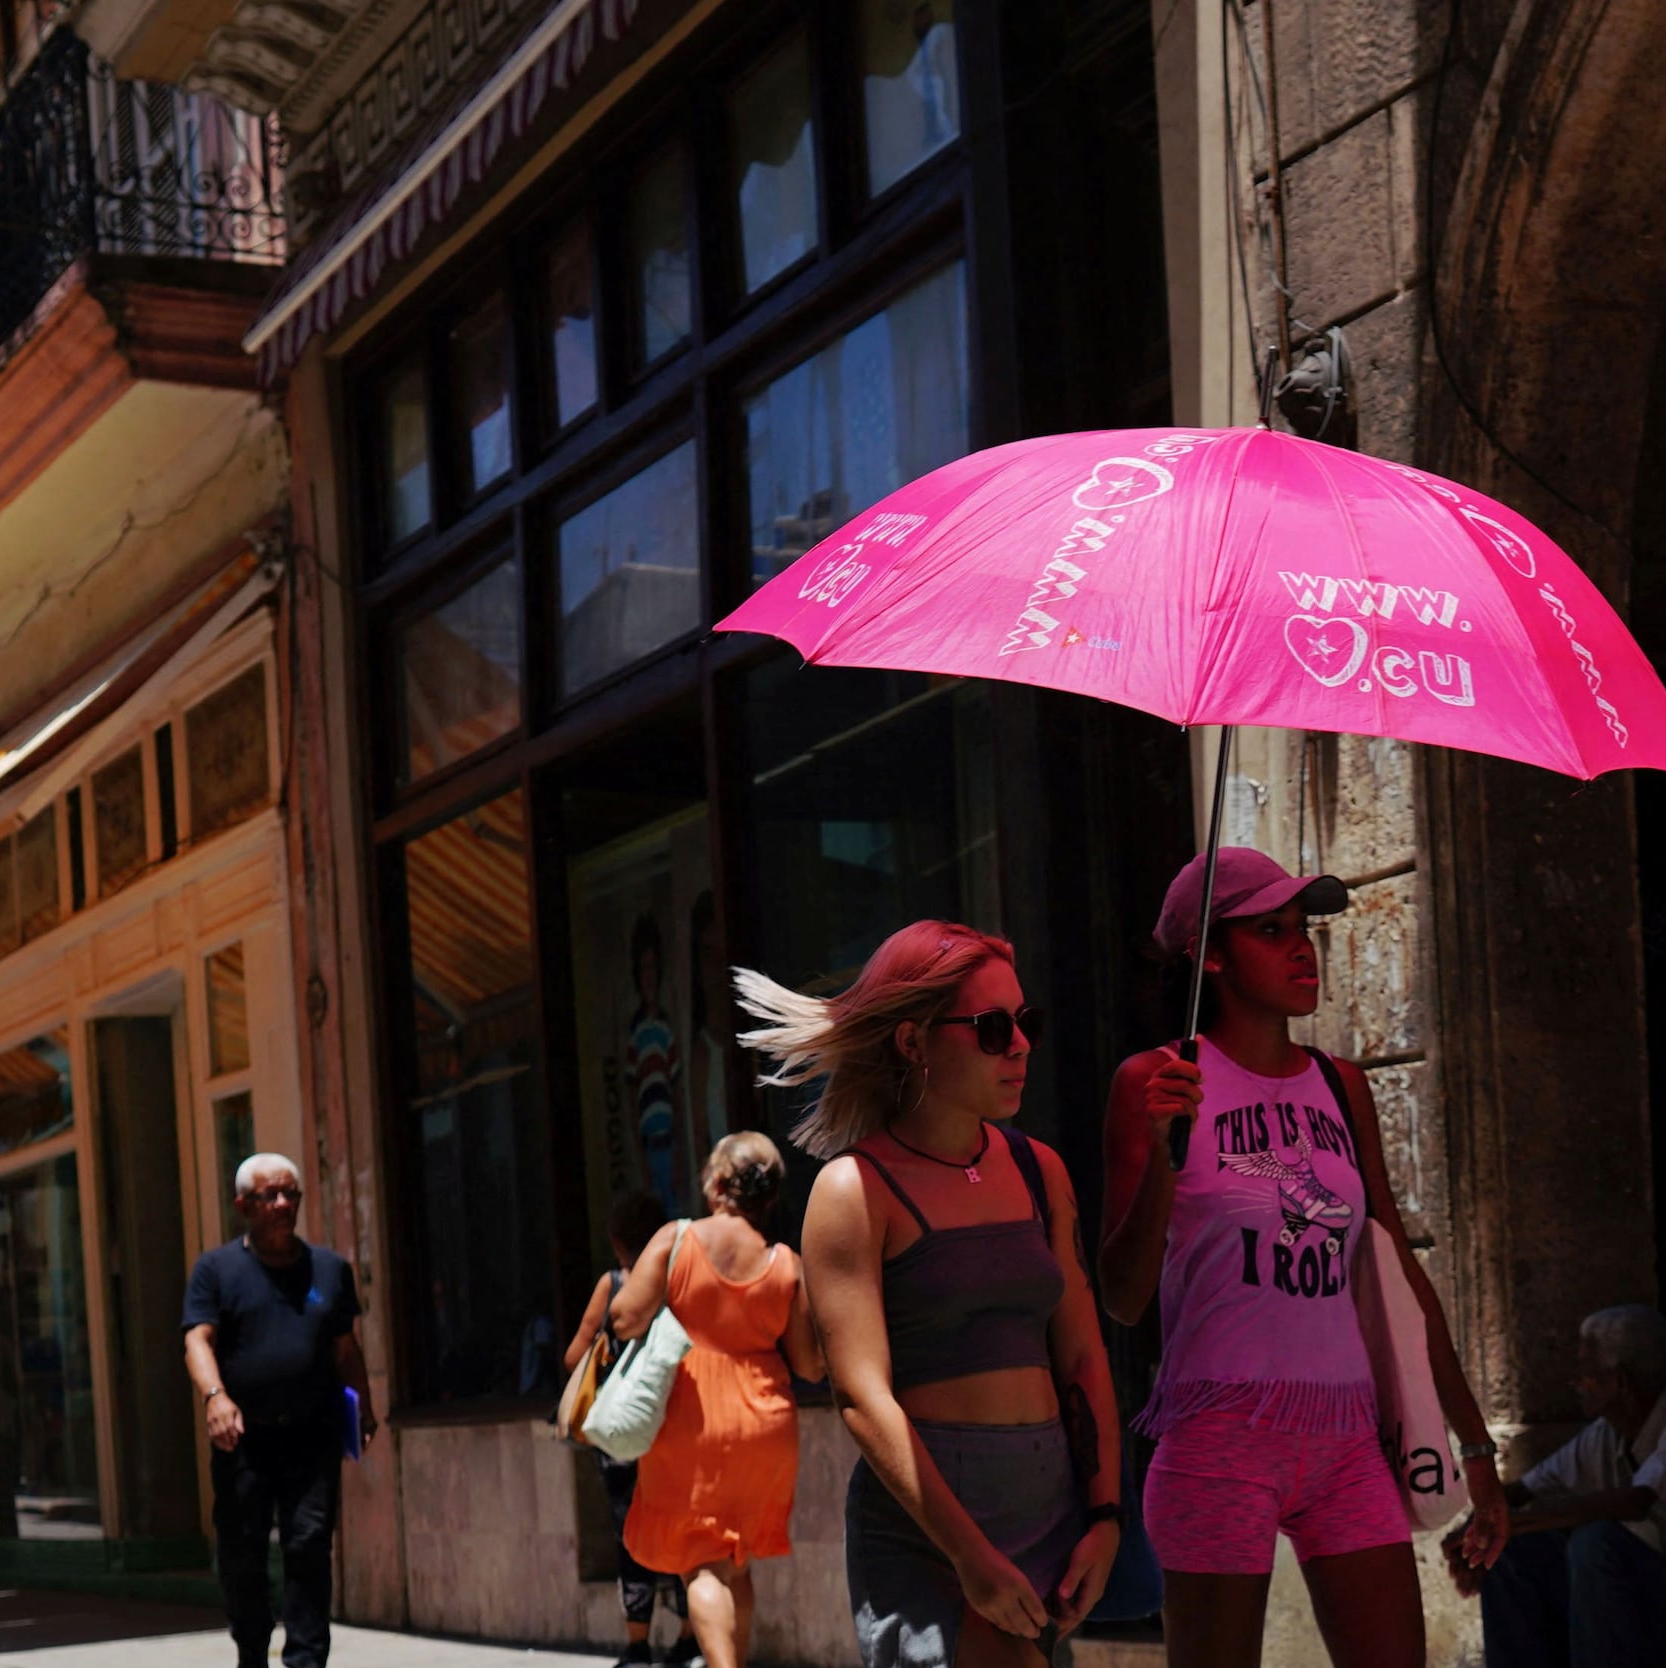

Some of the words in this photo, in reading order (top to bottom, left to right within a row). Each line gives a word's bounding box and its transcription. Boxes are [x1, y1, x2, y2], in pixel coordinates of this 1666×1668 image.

[1277, 570, 1473, 633] www.
[1214, 1102, 1271, 1172] THIS
[1276, 1102, 1300, 1147] IS
[1241, 1226, 1261, 1288] I
